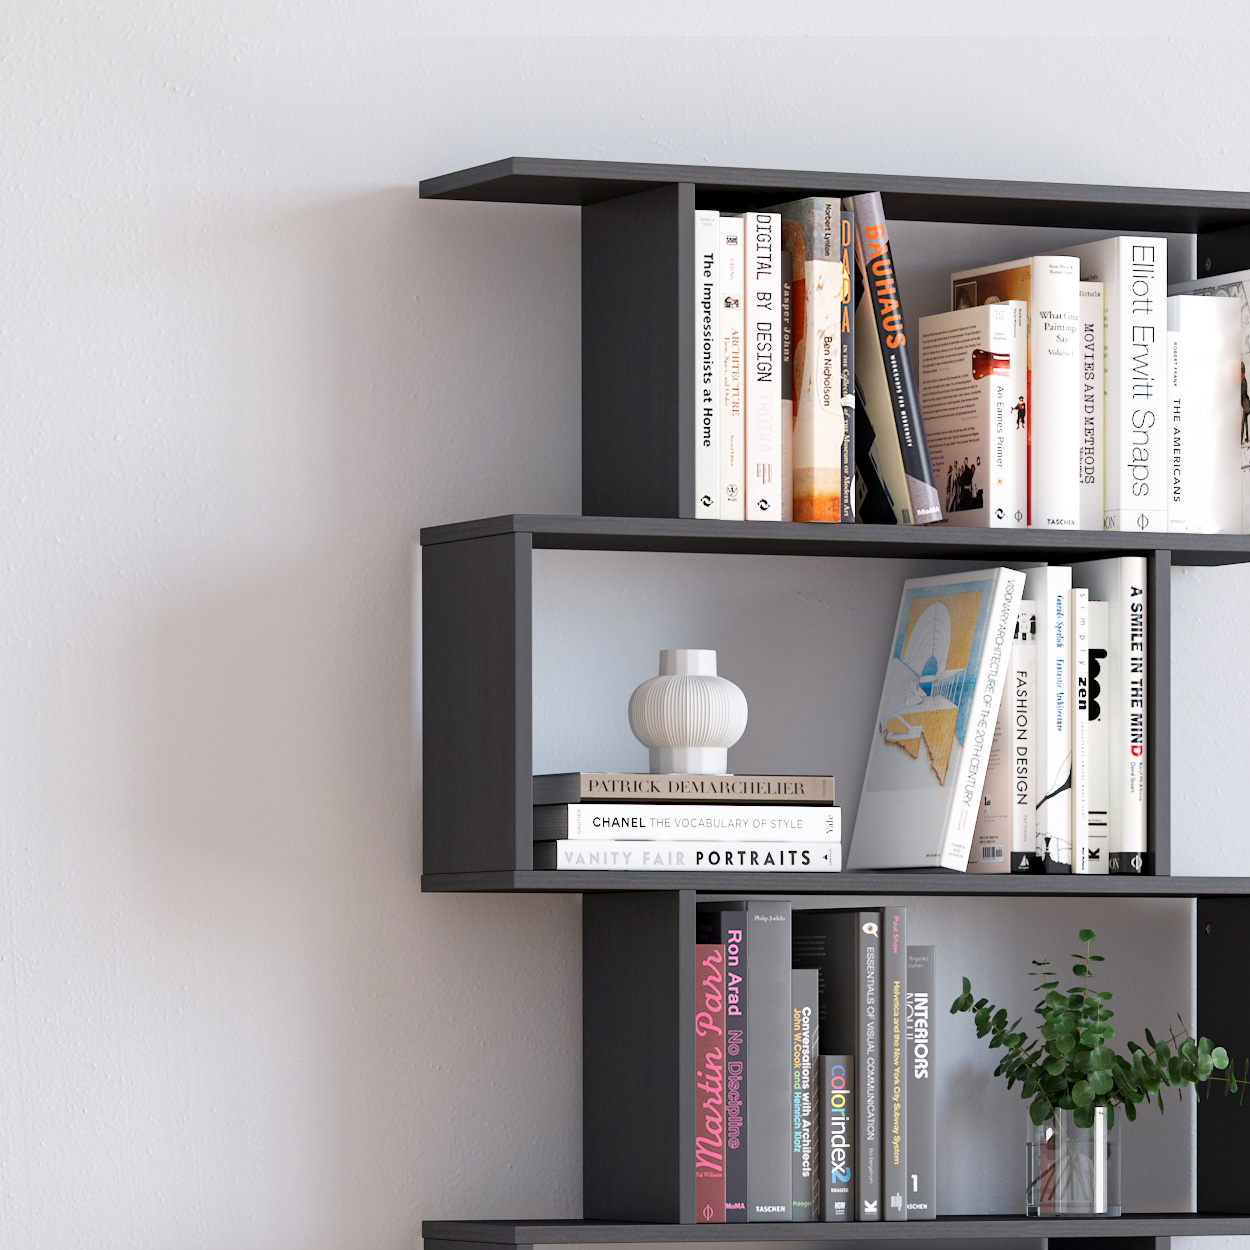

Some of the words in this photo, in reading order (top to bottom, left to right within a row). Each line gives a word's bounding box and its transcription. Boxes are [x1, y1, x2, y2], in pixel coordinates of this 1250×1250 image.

[703, 253, 714, 278] The
[756, 214, 772, 280] DIGITAL
[841, 219, 851, 333] DADA
[864, 223, 907, 349] BAUHAUS
[1132, 245, 1155, 315] Elliott
[756, 292, 772, 311] BY
[782, 282, 791, 324] Jasper
[701, 283, 714, 384] Impressionists
[756, 322, 772, 382] DESIGN
[783, 327, 791, 362] Johns
[823, 336, 833, 356] Ben
[1084, 323, 1095, 381] MOVIES
[731, 328, 740, 417] ARCHITECTURE
[1132, 325, 1155, 399] Erwitt
[703, 389, 713, 403] at
[823, 358, 833, 407] Nicholson
[996, 385, 1004, 399] An
[1084, 383, 1095, 414] AND
[703, 408, 713, 447] Home
[996, 401, 1005, 434] Eames
[1173, 398, 1181, 423] THE
[996, 436, 1004, 469] Primer
[1084, 417, 1095, 484] METHODS
[1127, 409, 1156, 497] Snaps
[1173, 426, 1181, 503] AMERICANS
[916, 505, 940, 516] MoMA
[1047, 518, 1075, 526] TASCHEN
[1130, 586, 1143, 597] A
[1130, 602, 1143, 651] SMILE
[1130, 657, 1143, 673] IN
[1016, 670, 1028, 740] FASHION
[1078, 677, 1087, 710] zen
[1130, 678, 1143, 708] THE
[1130, 713, 1143, 757] MIND
[589, 778, 661, 794] PATRICK
[668, 780, 806, 796] DEMARCHELIER
[1016, 747, 1028, 805] DESIGN
[592, 816, 646, 828] CHANEL
[650, 817, 671, 828] THE
[674, 817, 749, 829] VOCABULARY
[752, 818, 767, 829] OF
[770, 818, 804, 830] STYLE
[825, 814, 834, 834] Yale
[563, 851, 632, 866] VANITY
[643, 851, 686, 866] FAIR
[696, 850, 811, 866] PORTRAITS
[727, 929, 743, 967] Ron
[696, 949, 723, 1037] Parr
[727, 972, 743, 1016] Arad
[866, 946, 875, 1004] ESSENTIALS
[866, 1006, 875, 1020] OF
[727, 1029, 743, 1056] No
[801, 1006, 812, 1090] Conversations
[866, 1022, 875, 1055] VISUAL
[914, 992, 929, 1079] INTERIORS
[696, 1046, 723, 1172] Martin
[725, 1061, 743, 1149] Discipline
[801, 1092, 812, 1117] with
[866, 1057, 875, 1141] COMMUNICATION
[892, 1086, 900, 1101] City
[892, 1103, 900, 1134] Subway
[801, 1119, 812, 1178] Architects
[892, 1135, 900, 1165] System
[755, 1205, 786, 1213] TASCHEN
